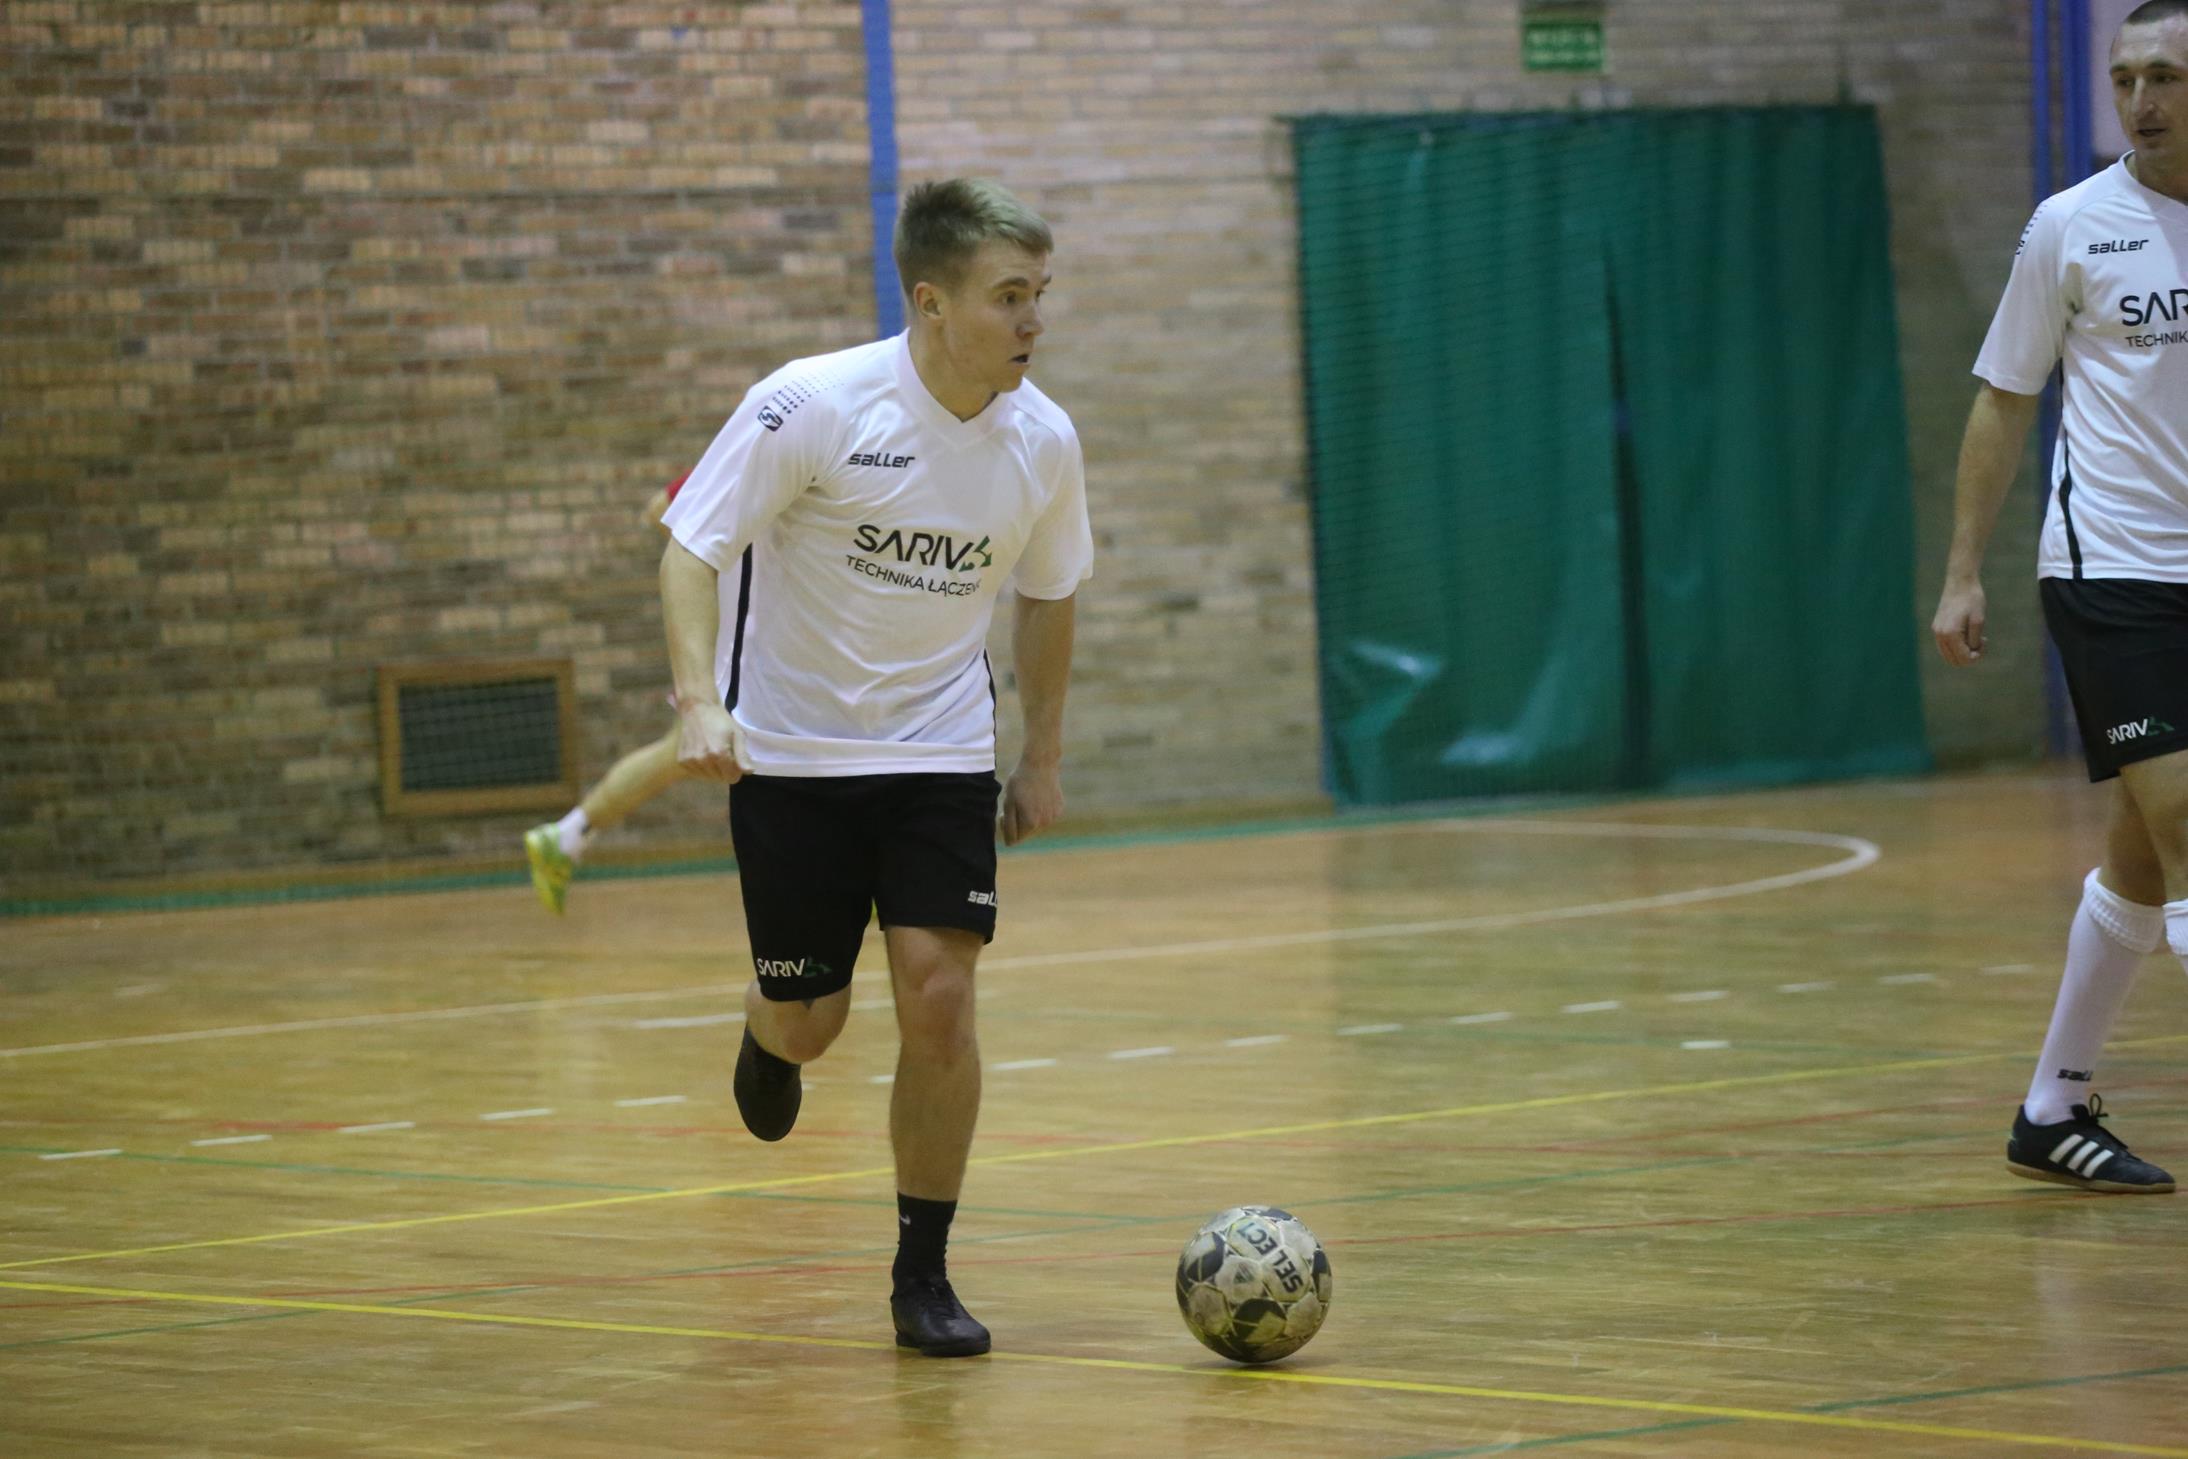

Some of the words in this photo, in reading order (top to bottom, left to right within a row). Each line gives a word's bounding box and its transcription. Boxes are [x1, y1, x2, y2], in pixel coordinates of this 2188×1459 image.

[2088, 239, 2149, 254] saller
[848, 452, 915, 468] saller
[853, 524, 975, 570] SARIV
[846, 555, 925, 590] TECHNIKA
[757, 958, 805, 977] SARIV
